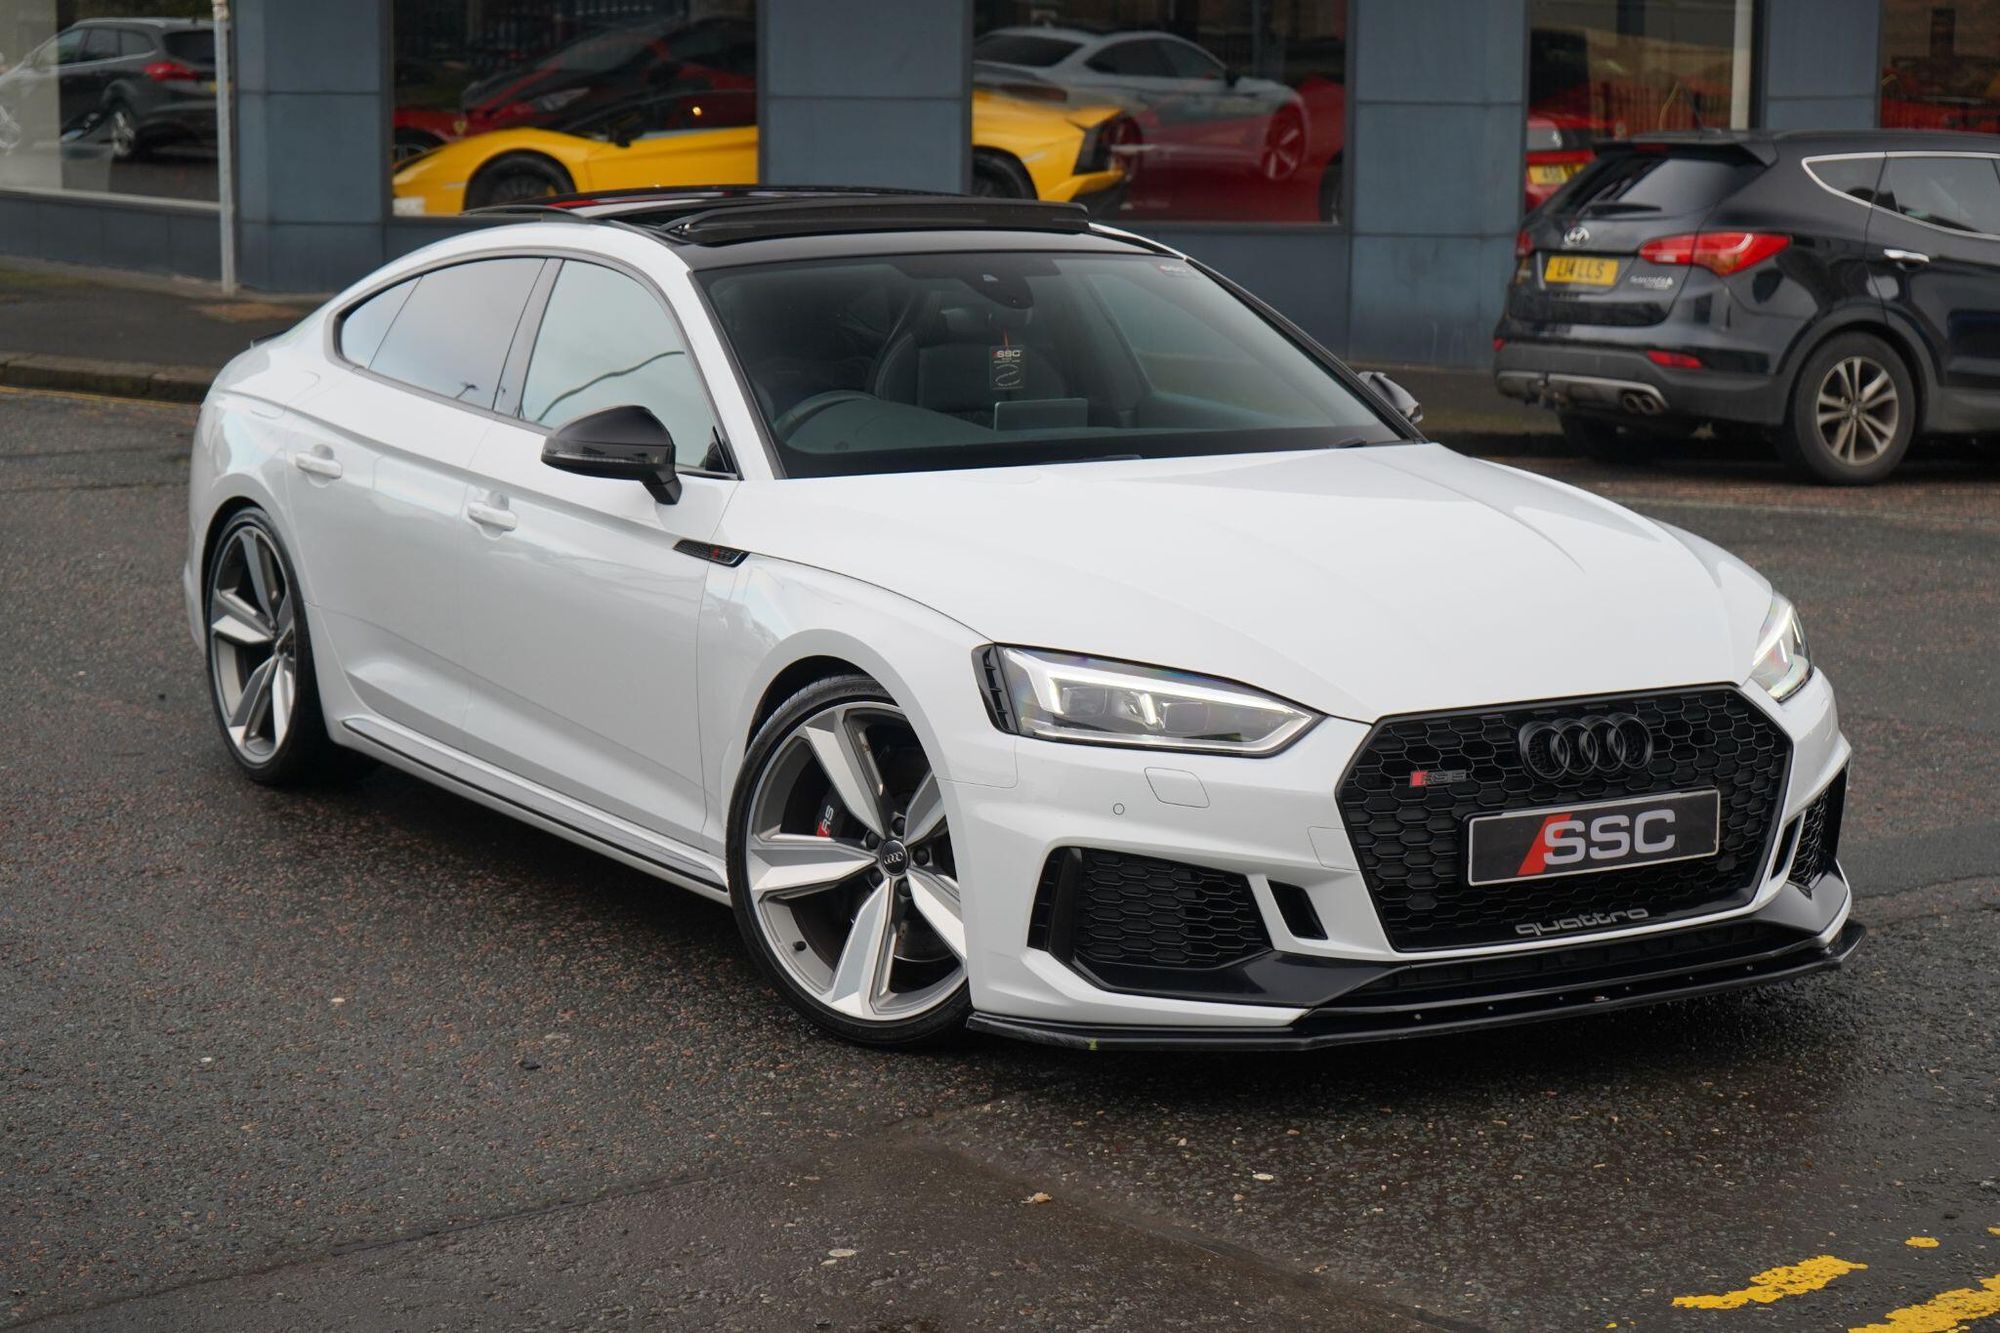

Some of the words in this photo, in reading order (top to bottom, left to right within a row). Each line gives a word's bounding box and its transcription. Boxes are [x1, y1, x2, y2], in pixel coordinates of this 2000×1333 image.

[822, 805, 834, 835] RS
[1543, 809, 1676, 865] SSC
[1515, 908, 1649, 936] quattro
